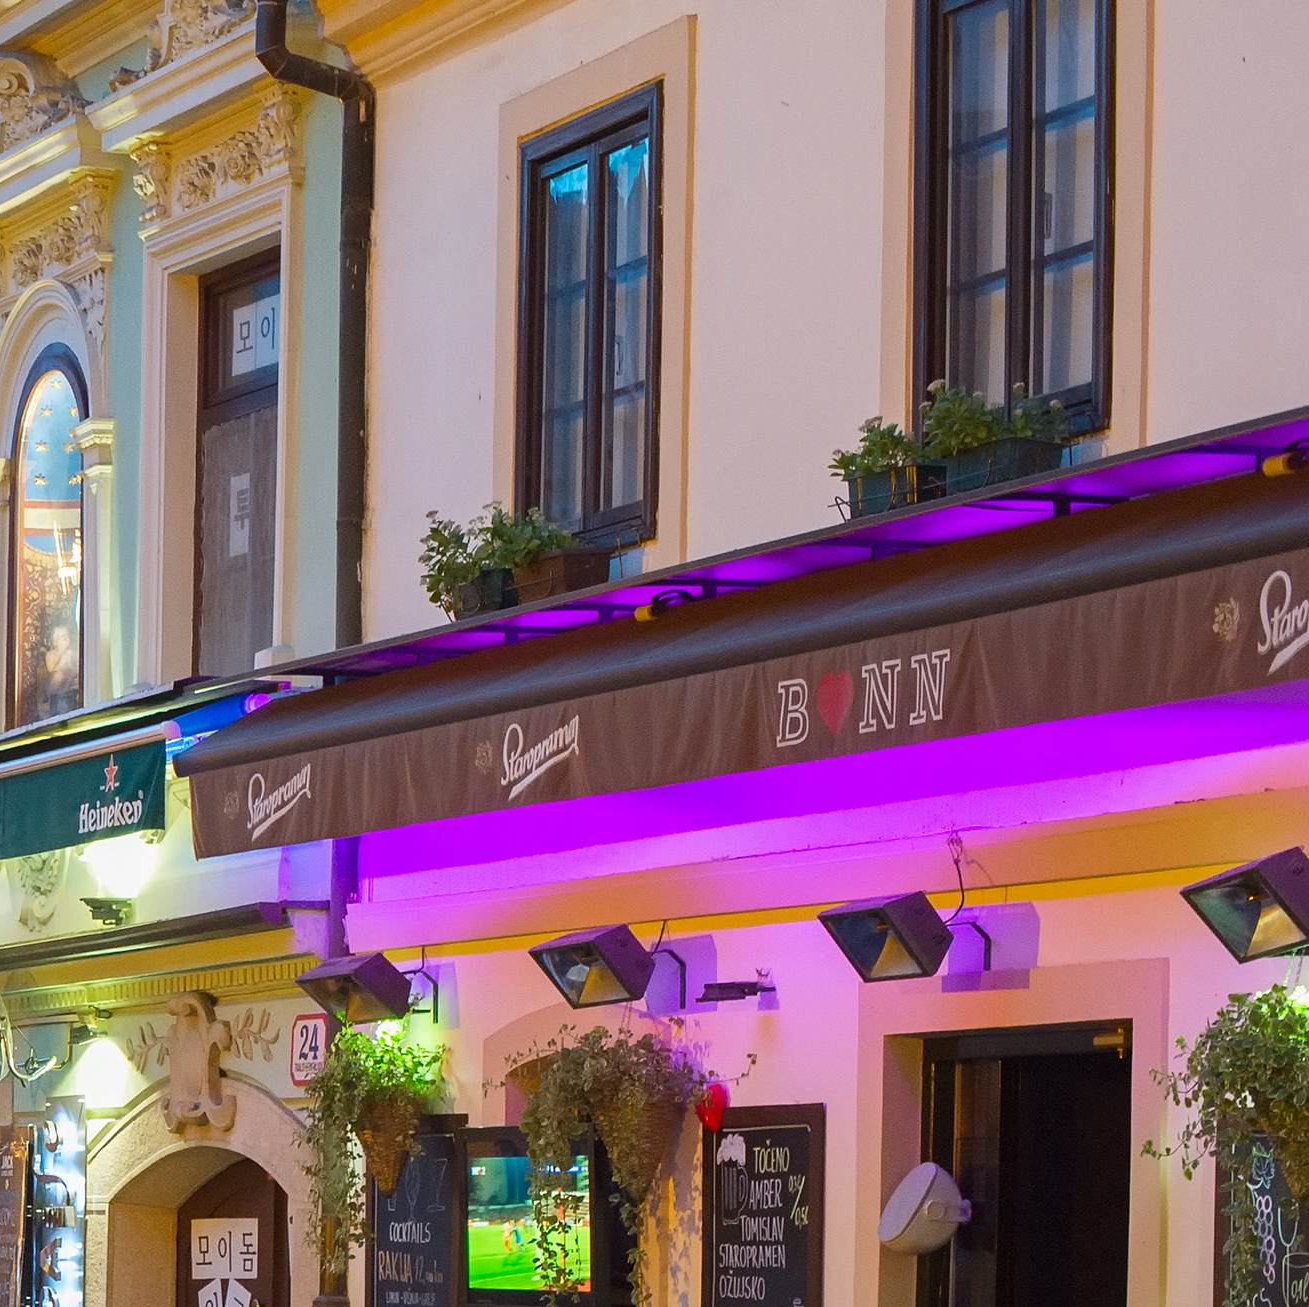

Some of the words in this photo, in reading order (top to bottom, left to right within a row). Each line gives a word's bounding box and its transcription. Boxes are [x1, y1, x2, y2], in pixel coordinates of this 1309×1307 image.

[78, 797, 144, 833] Heineken
[299, 1024, 319, 1060] 24
[753, 1139, 790, 1174] TOČENO
[749, 1179, 783, 1210] AMBER
[389, 1221, 432, 1244] COCKTAILS
[740, 1215, 784, 1242] TOMISLAV
[196, 1231, 257, 1273] 모이돔
[719, 1243, 786, 1269] STAROPRAMEN
[719, 1270, 766, 1300] OŽUJSKO
